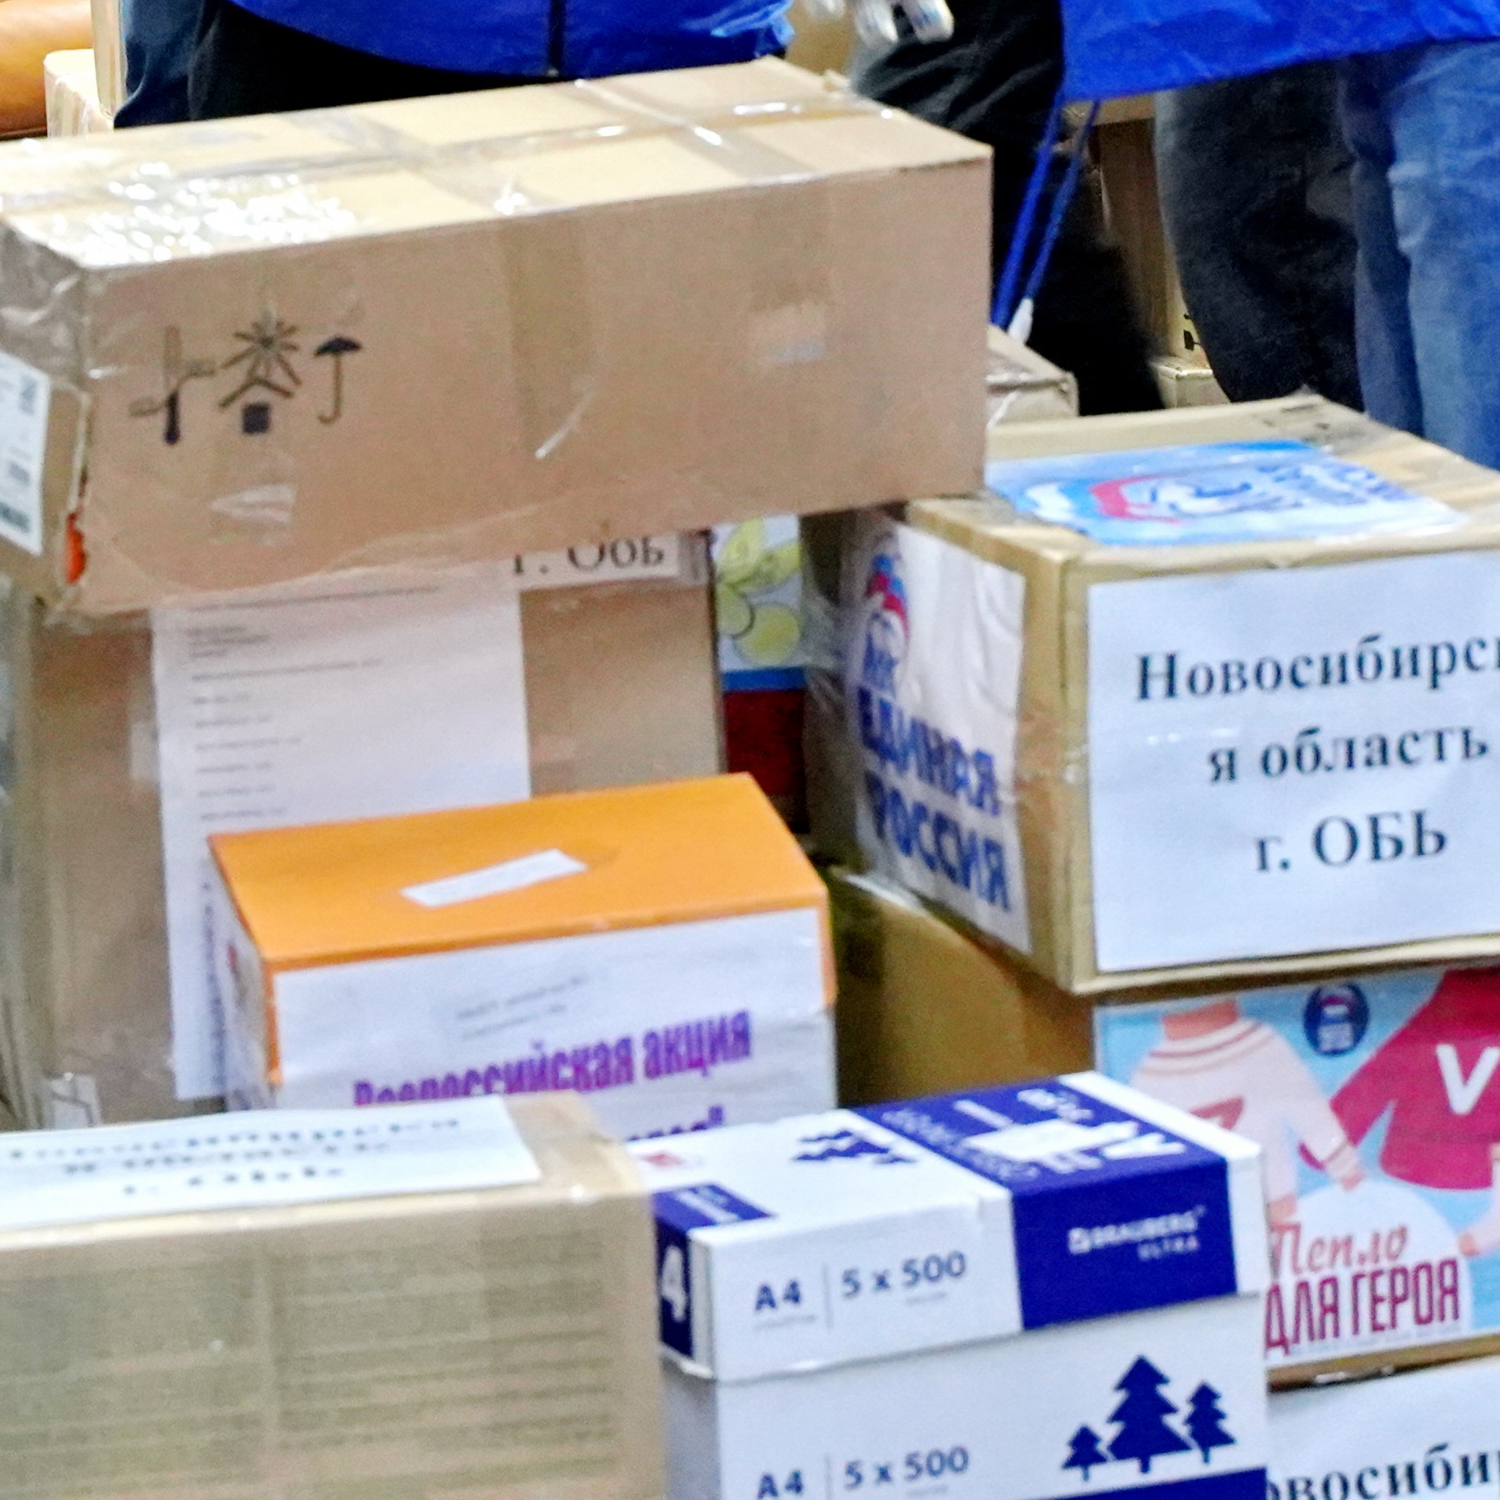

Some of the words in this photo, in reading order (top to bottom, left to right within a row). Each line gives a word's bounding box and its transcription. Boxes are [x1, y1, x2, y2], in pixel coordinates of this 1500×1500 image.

[857, 684, 1000, 818] ЕДИНАЯ
[1208, 746, 1238, 785] я
[1259, 724, 1491, 778] область
[864, 767, 1012, 913] РОССИЯ
[1254, 835, 1292, 873] г.
[1310, 807, 1449, 869] ОБЬ
[642, 1009, 752, 1080] акция
[754, 1276, 803, 1313] A4
[841, 1268, 862, 1301] 5
[901, 1249, 967, 1288] 500
[1264, 1275, 1340, 1359] ДЛЯ
[1351, 1257, 1461, 1336] ГЕРОЯ
[755, 1468, 805, 1500] A4
[845, 1458, 864, 1492] 5
[904, 1443, 970, 1483] 500
